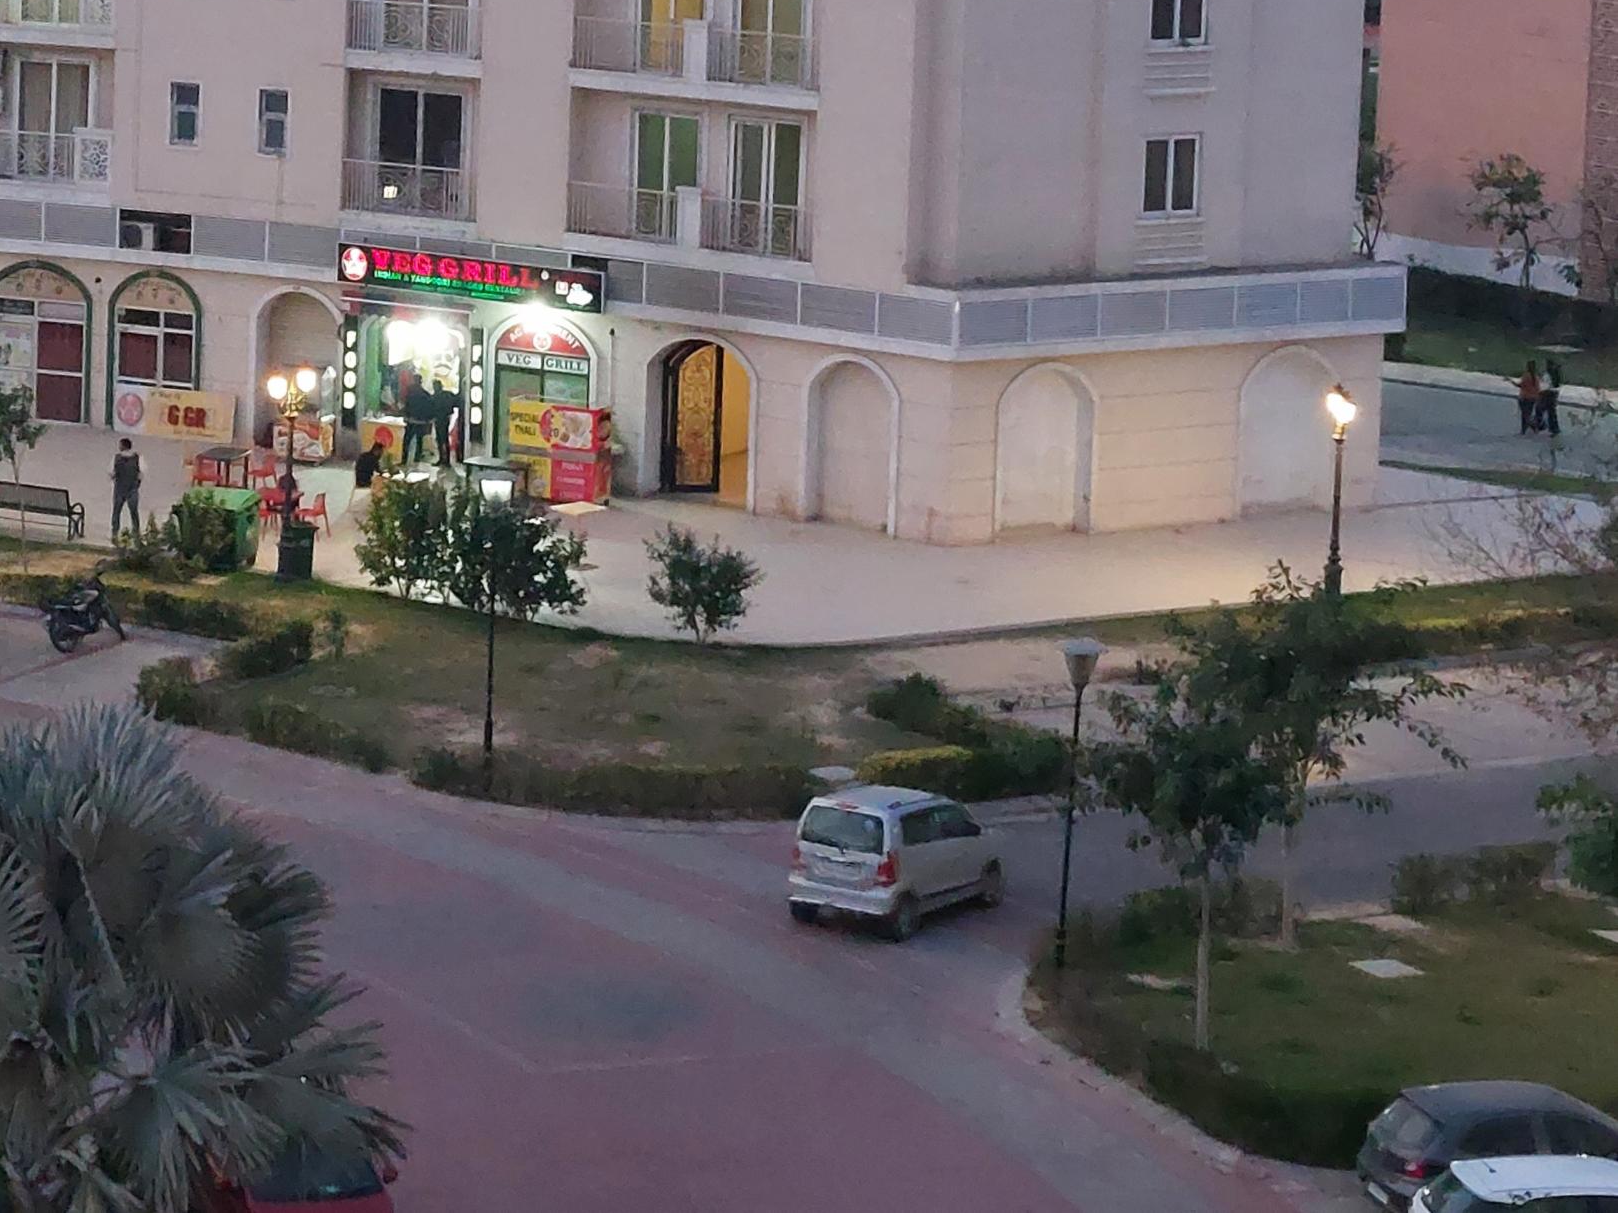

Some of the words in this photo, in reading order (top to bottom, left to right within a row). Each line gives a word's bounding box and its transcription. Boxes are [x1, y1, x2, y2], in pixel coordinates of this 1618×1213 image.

[371, 248, 432, 276] VEG
[436, 255, 540, 290] GRILL
[506, 353, 532, 366] VEG
[545, 358, 585, 371] GRILL
